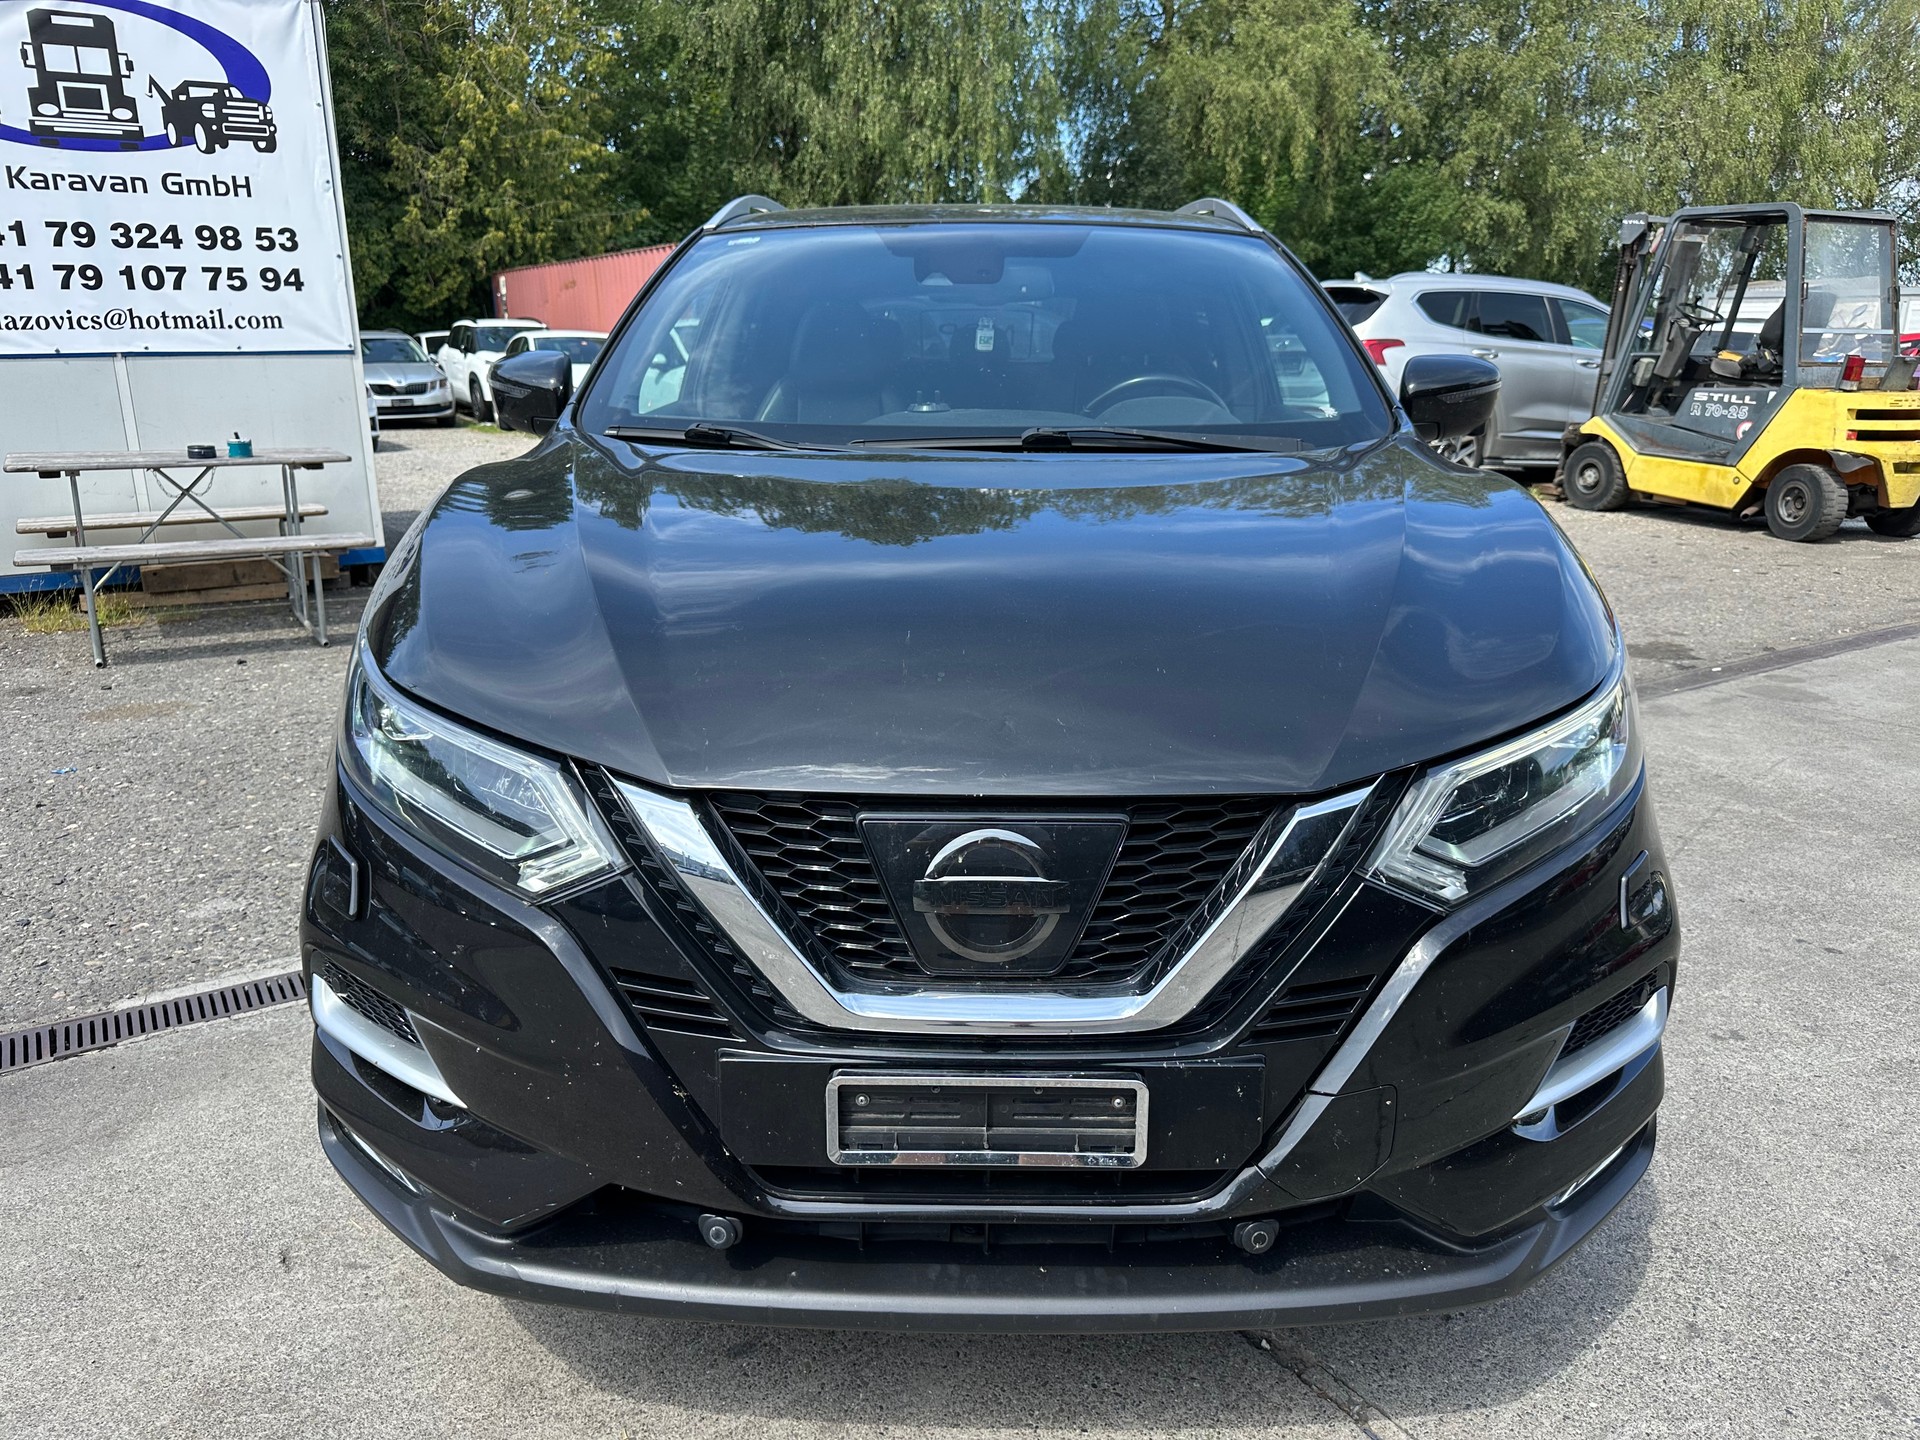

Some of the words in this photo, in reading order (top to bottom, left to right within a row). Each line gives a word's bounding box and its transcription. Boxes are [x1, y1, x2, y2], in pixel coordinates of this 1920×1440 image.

[5, 165, 149, 194] Karavan
[161, 172, 252, 198] GmbH
[44, 221, 96, 248] 79
[109, 222, 184, 250] 324
[194, 225, 243, 251] 98
[255, 227, 299, 252] 53
[52, 264, 103, 291] 79
[118, 265, 187, 291] 107
[201, 266, 248, 292] 75
[259, 267, 305, 292] 94
[0, 307, 284, 331] azovics@hotmail.com
[1693, 391, 1757, 405] STILL
[1690, 402, 1702, 416] R
[1704, 403, 1749, 419] 70-25
[926, 884, 1056, 907] NISSAN
